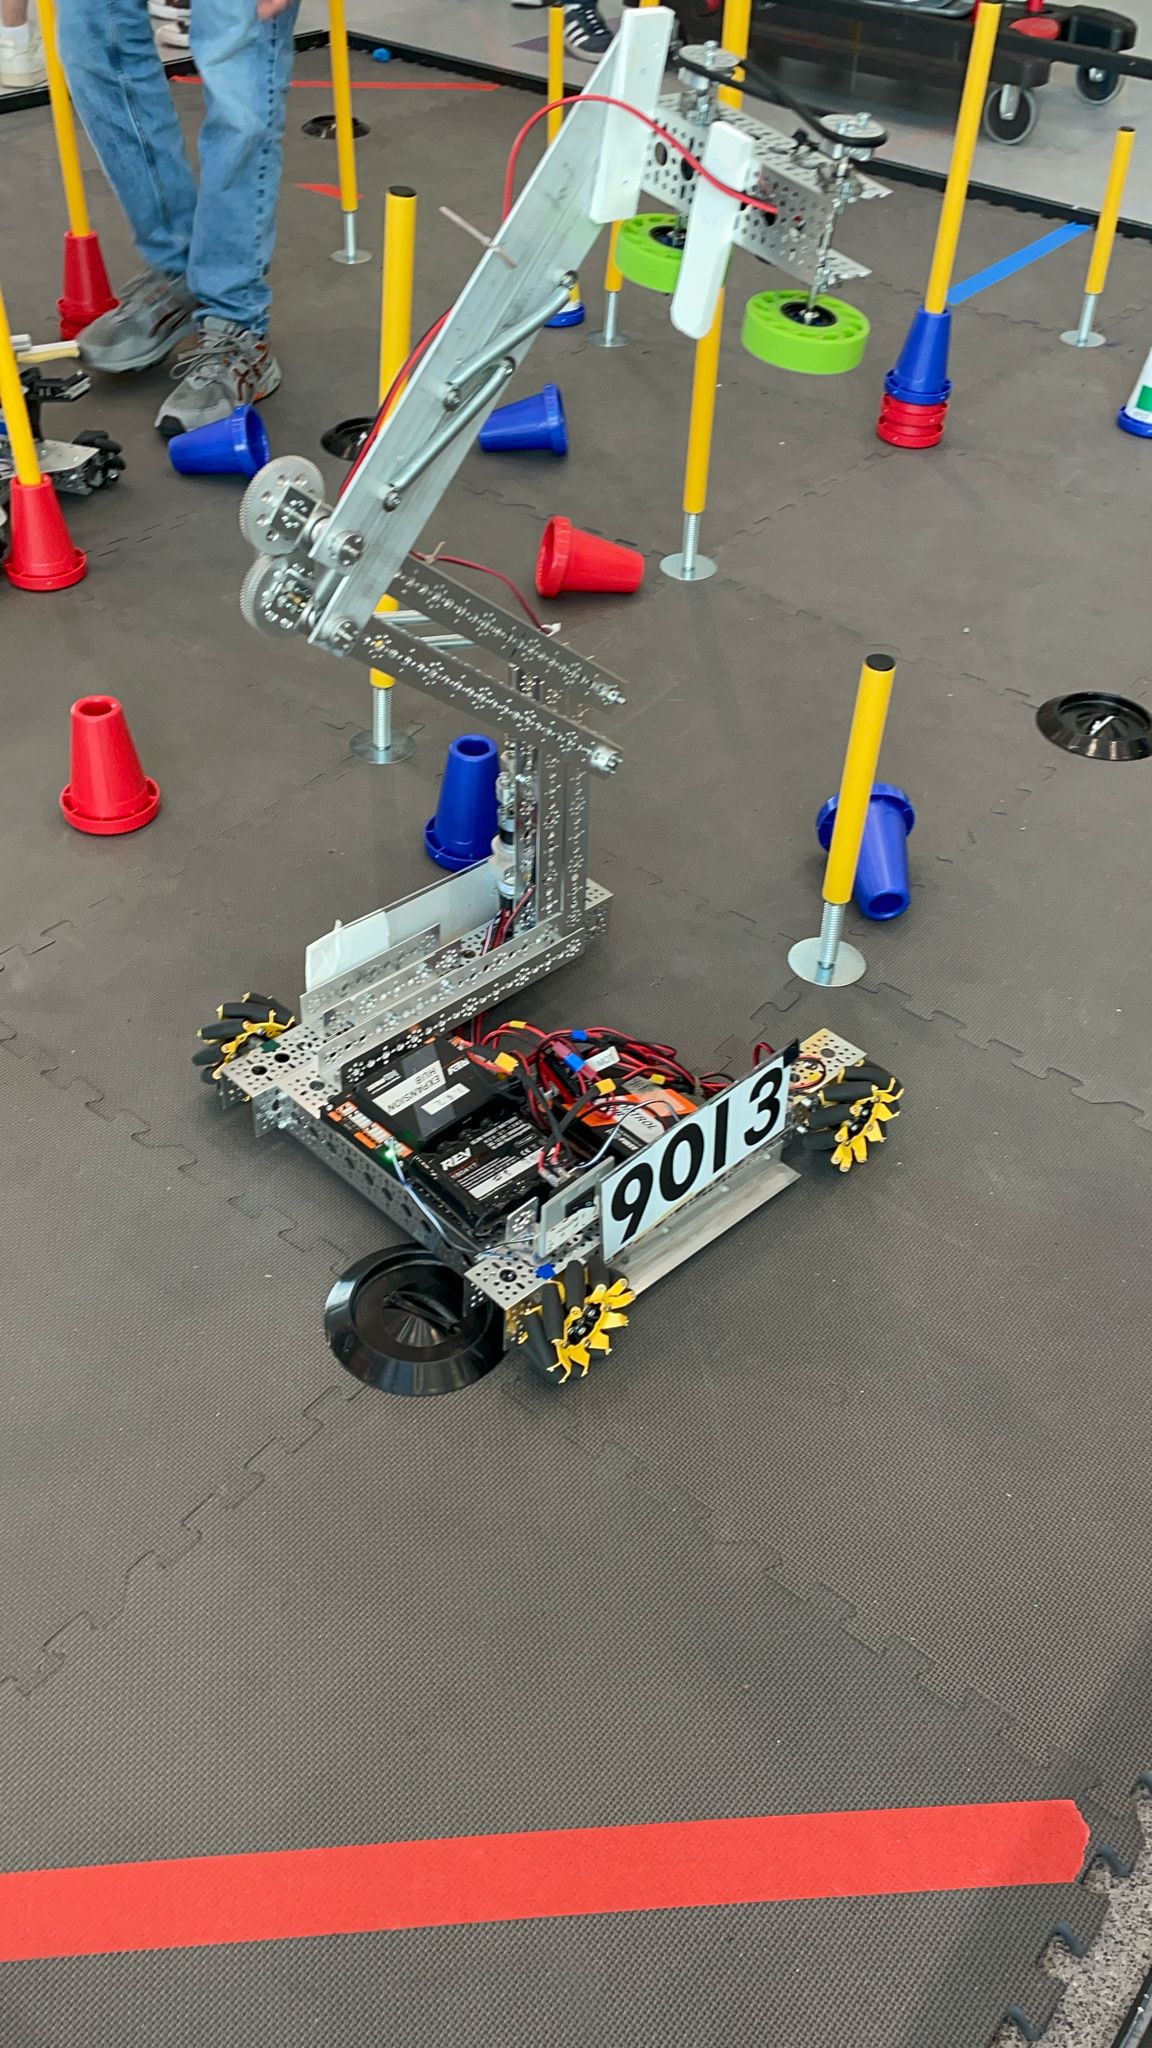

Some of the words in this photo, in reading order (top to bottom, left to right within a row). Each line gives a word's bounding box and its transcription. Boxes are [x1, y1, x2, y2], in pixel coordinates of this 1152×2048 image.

[414, 1067, 437, 1085] HUB
[387, 1074, 441, 1112] EXPANSION
[440, 1146, 472, 1171] REV
[611, 1066, 783, 1245] 9013
